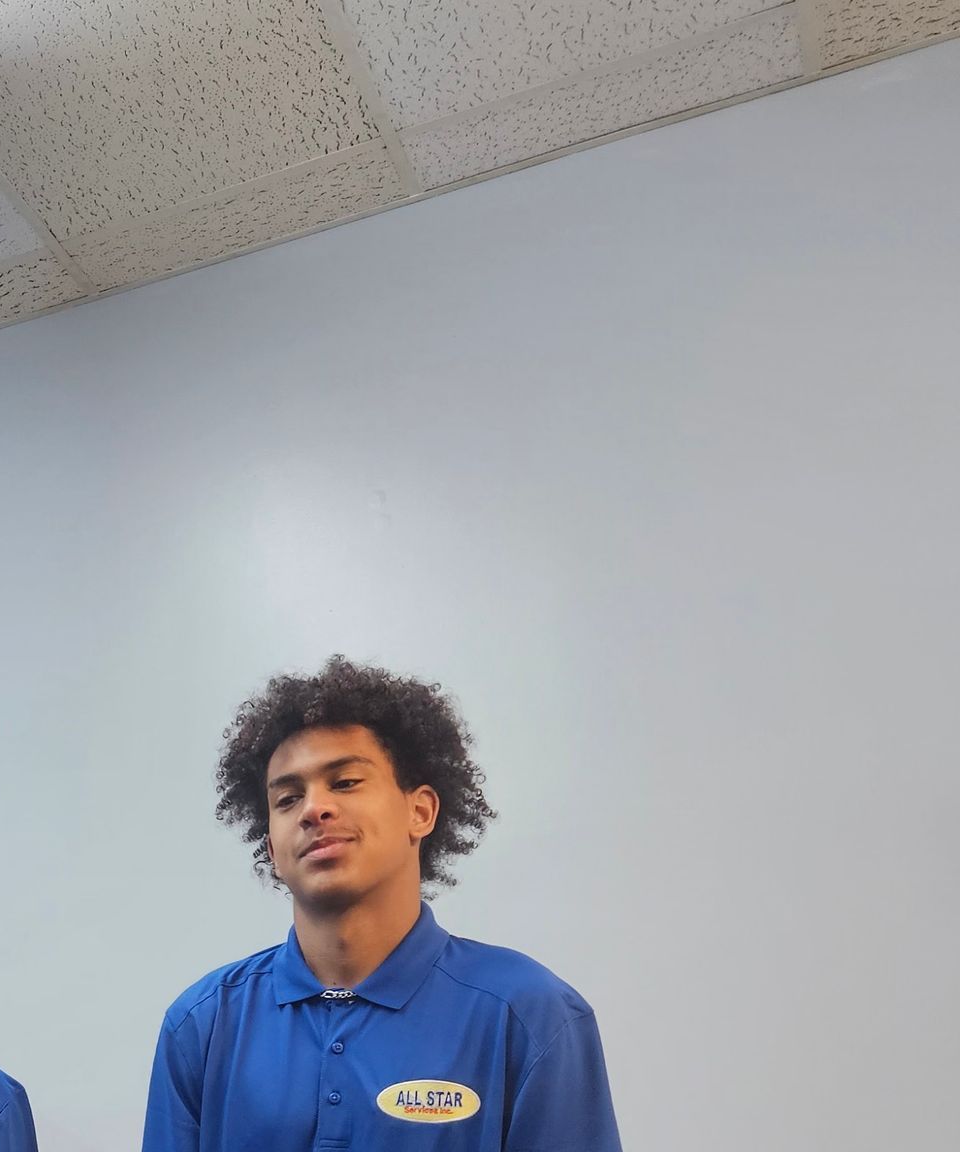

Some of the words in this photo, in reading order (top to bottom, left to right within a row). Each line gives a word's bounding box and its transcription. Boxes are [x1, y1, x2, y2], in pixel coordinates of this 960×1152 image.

[396, 1090, 421, 1106] ALL
[427, 1090, 463, 1107] STAR
[404, 1106, 439, 1115] Services
